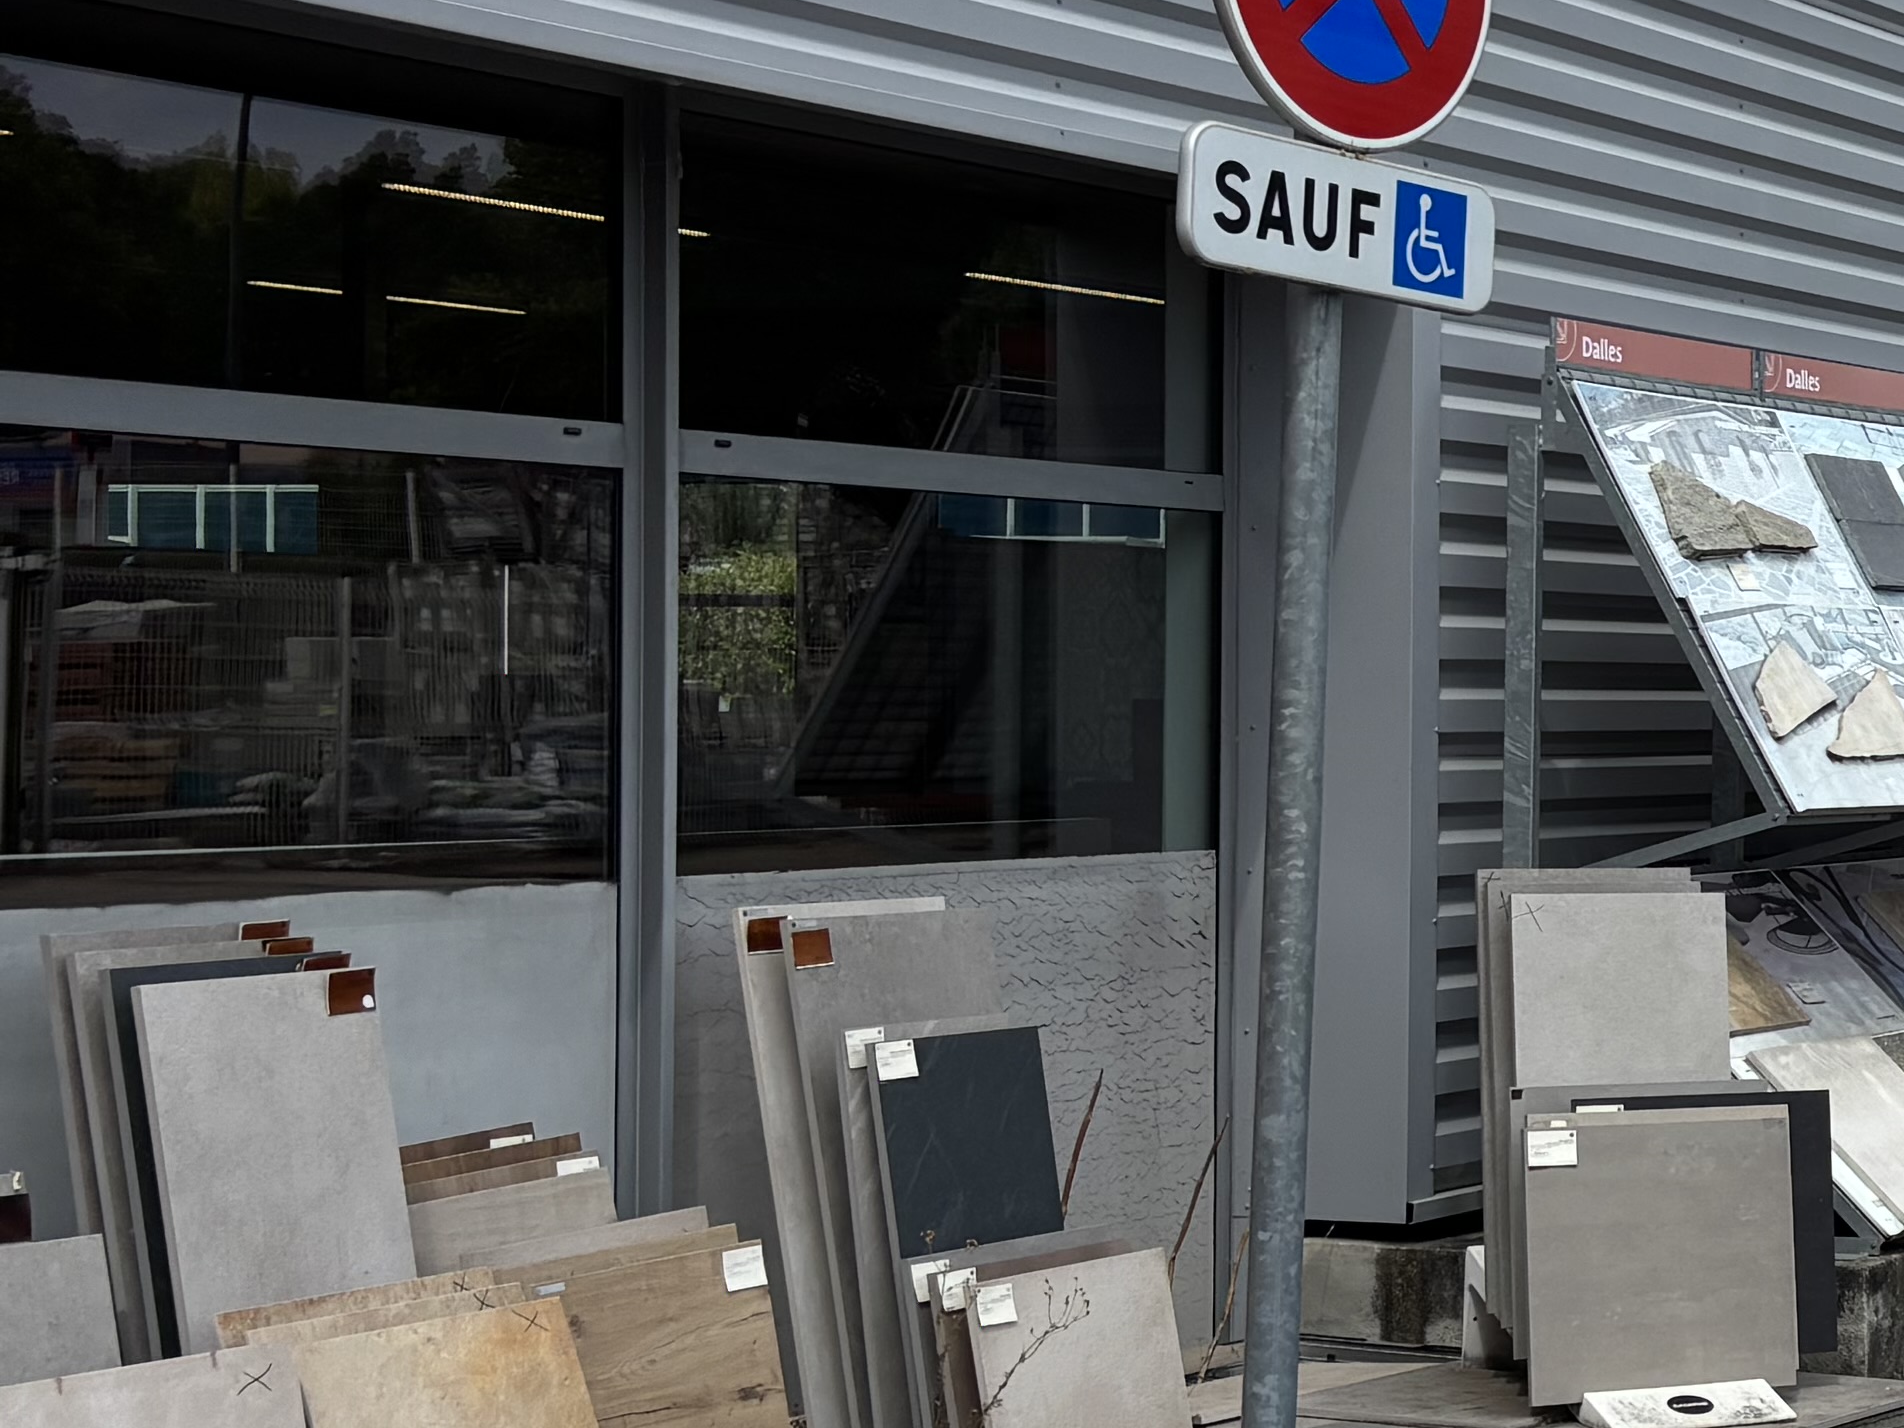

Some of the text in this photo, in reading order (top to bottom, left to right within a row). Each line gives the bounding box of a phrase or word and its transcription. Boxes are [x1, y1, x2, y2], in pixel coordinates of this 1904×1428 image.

[1212, 159, 1381, 259] SAUF
[1581, 335, 1623, 363] Dalles
[1785, 368, 1821, 392] Dalles
